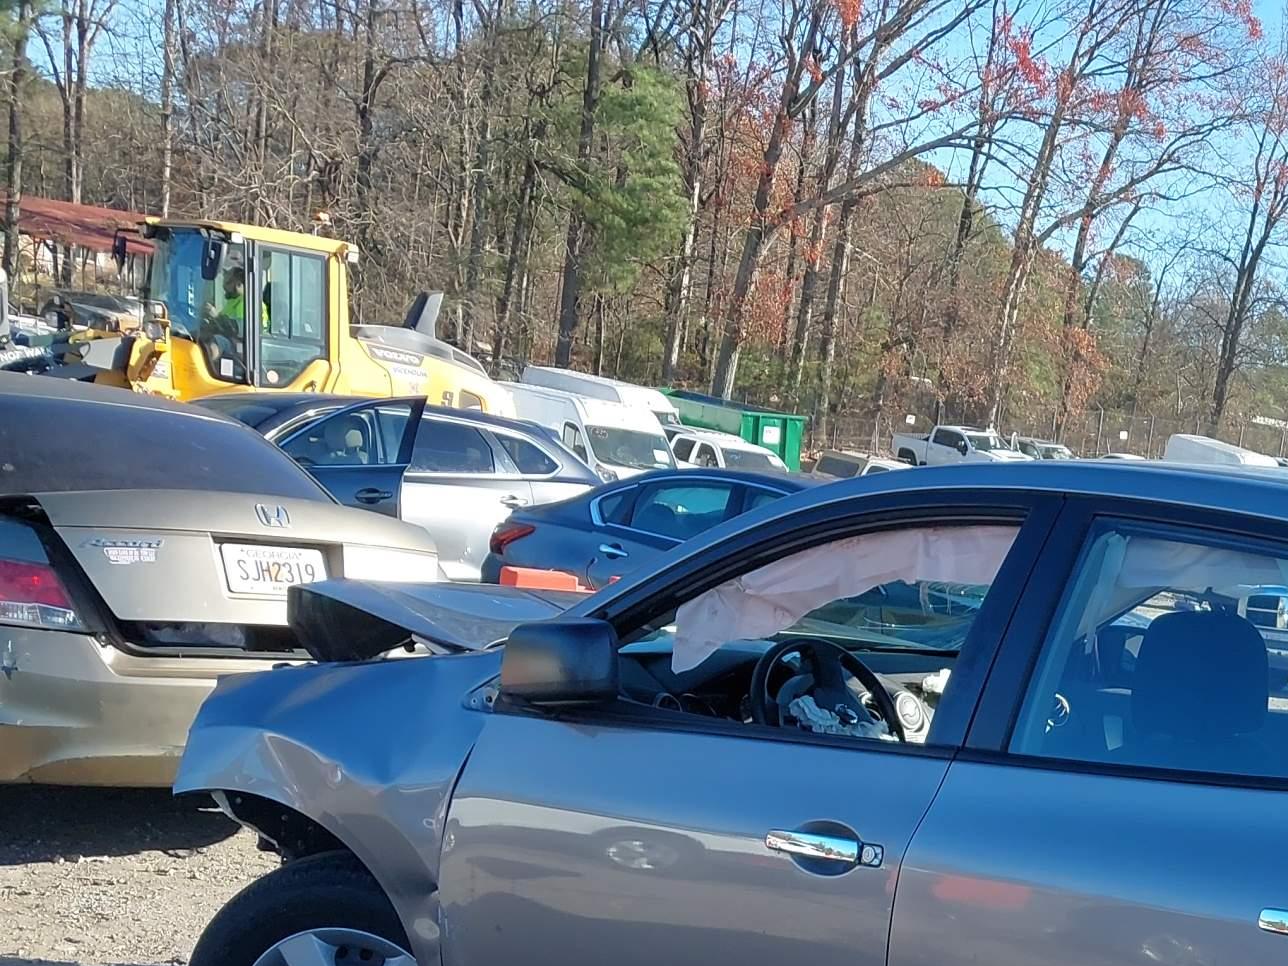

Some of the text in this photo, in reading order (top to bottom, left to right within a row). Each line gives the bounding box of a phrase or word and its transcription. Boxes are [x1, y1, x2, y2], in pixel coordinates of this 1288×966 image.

[372, 347, 420, 364] VOLVO
[246, 549, 300, 561] GEORGIA
[236, 559, 316, 584] SJH2319
